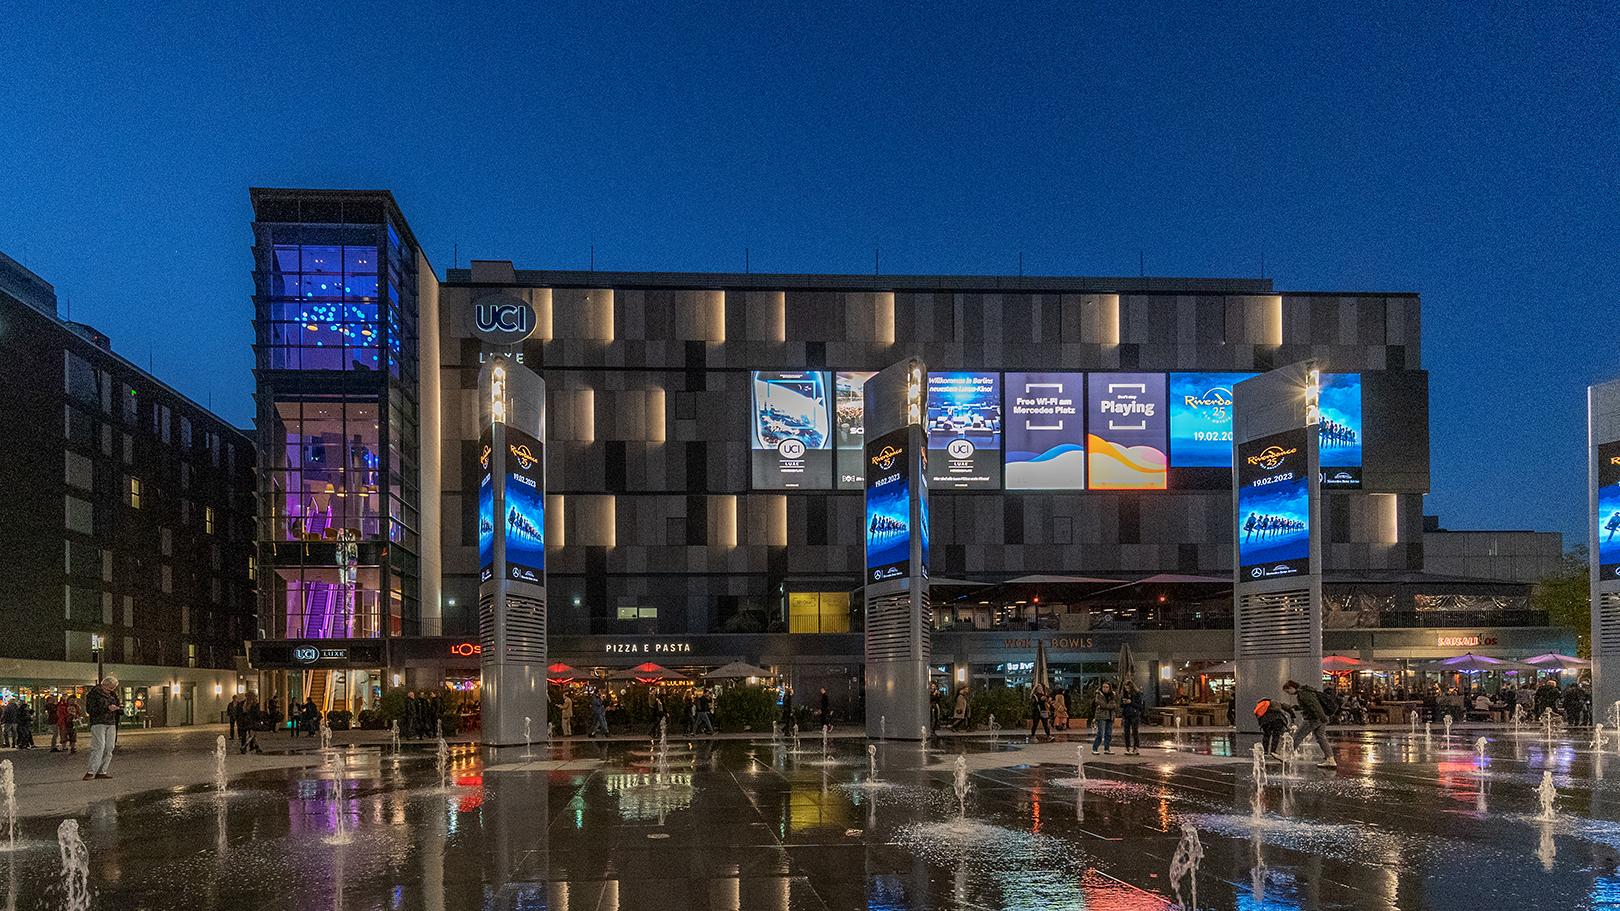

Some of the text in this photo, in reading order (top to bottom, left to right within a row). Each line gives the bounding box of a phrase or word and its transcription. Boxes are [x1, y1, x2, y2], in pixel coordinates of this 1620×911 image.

[475, 304, 527, 332] UCI
[1016, 397, 1035, 405] Free
[1036, 397, 1058, 405] Wi-Fi
[1013, 406, 1076, 414] Mercedes Platz
[1101, 400, 1155, 416] Playing
[1212, 407, 1226, 418] 25
[783, 445, 801, 454] UCI
[952, 445, 969, 454] UCI
[1266, 457, 1277, 467] 25
[1253, 472, 1293, 487] 19.02.2023
[606, 643, 691, 653] PIZZA E PASTA
[1051, 638, 1093, 649] BOWLS
[295, 648, 316, 660] UCI
